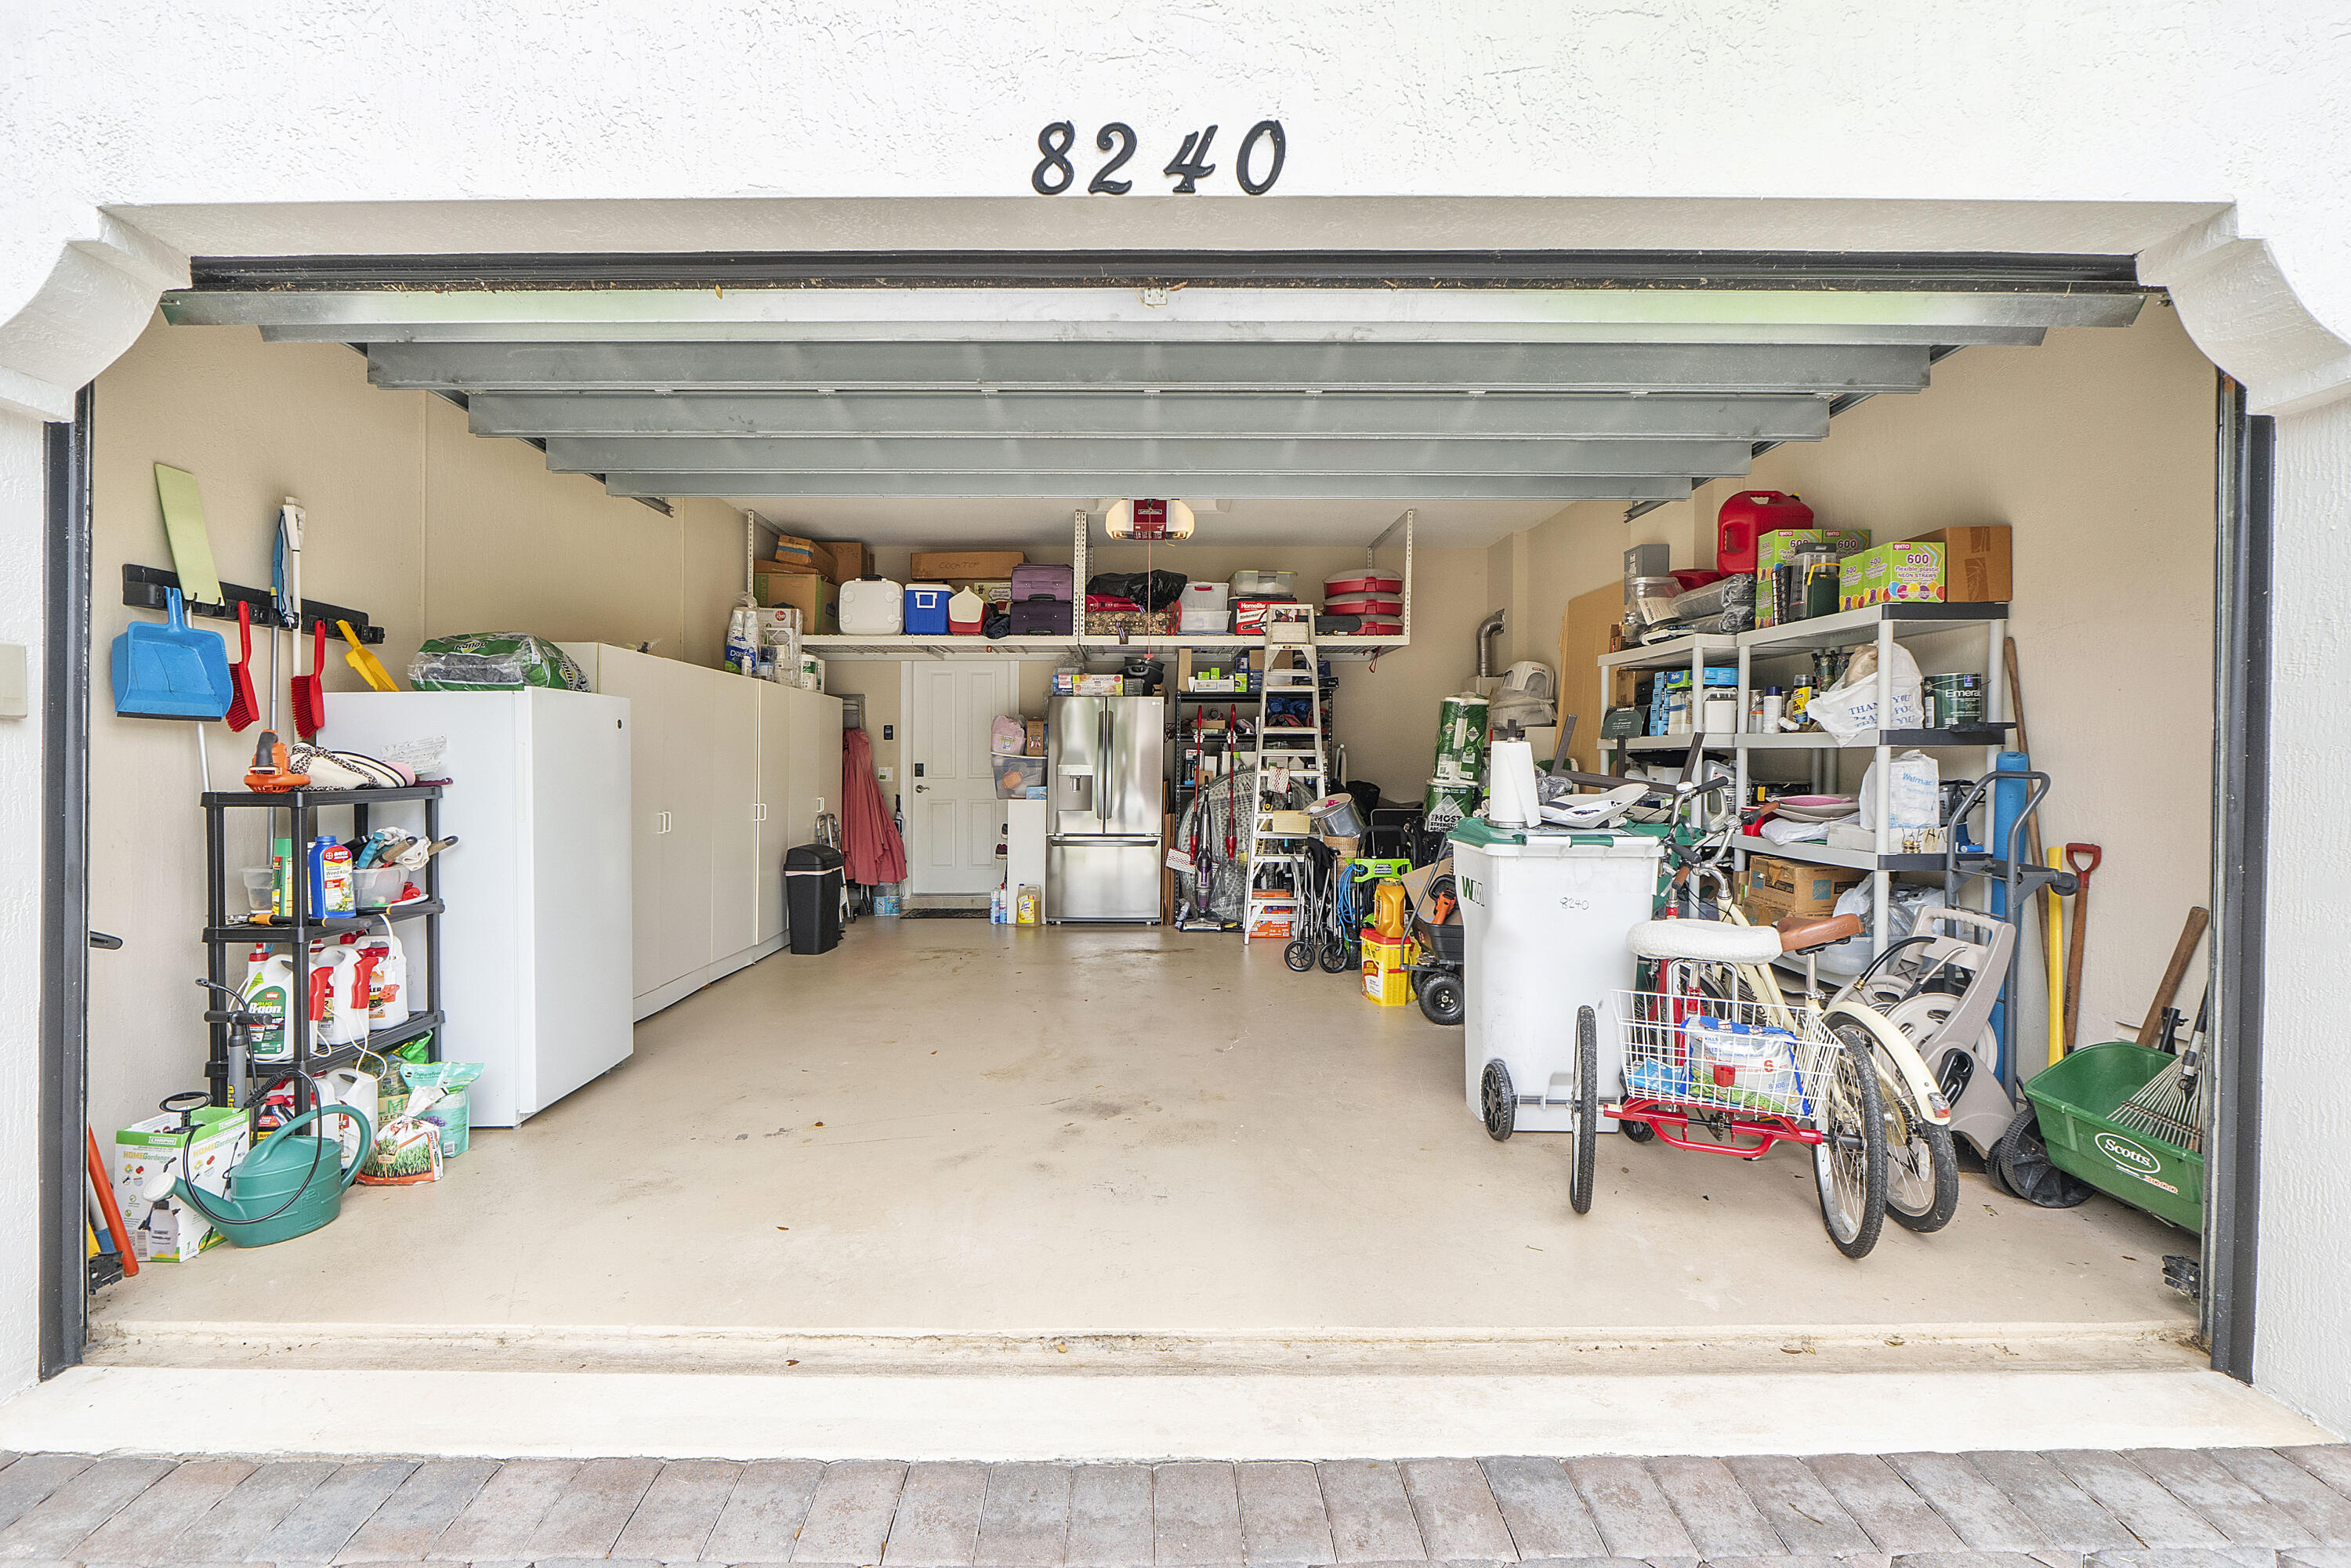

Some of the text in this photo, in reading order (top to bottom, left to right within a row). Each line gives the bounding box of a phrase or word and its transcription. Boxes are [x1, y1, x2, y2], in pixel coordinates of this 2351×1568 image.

[1031, 120, 1286, 195] 8240
[1870, 557, 1881, 566] 600
[1907, 554, 1929, 563] 600
[1846, 566, 1857, 574] 600
[1849, 702, 1878, 715] THAN
[1462, 875, 1485, 907] WM
[1559, 896, 1589, 911] 8240
[2105, 1139, 2150, 1167] Scotts
